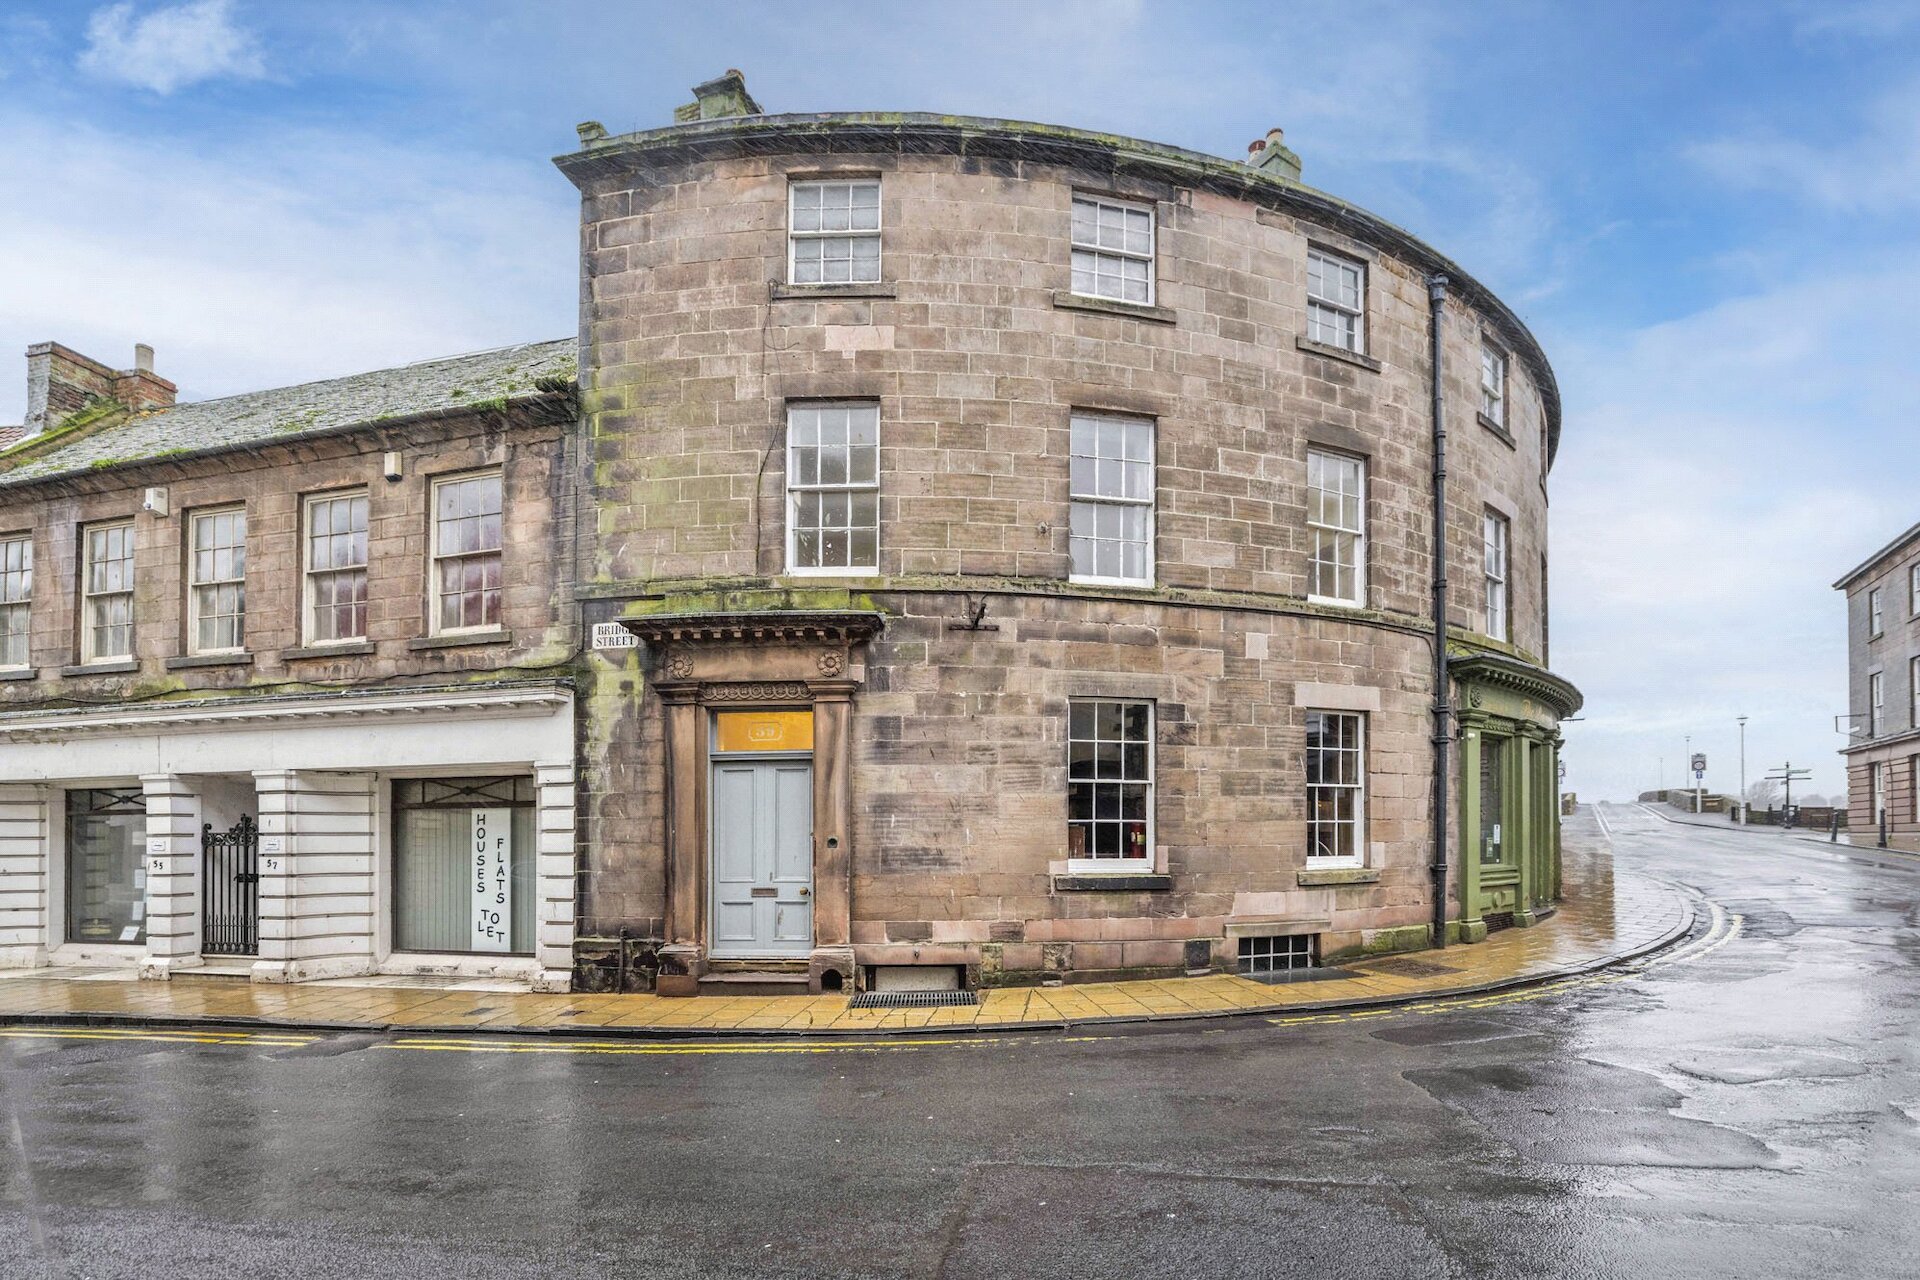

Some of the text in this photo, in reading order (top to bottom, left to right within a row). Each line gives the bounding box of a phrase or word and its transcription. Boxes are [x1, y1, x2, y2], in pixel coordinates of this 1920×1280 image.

[596, 636, 634, 647] STREET
[476, 814, 486, 893] HOUSES
[153, 860, 164, 870] 55
[267, 859, 278, 870] 57
[496, 838, 505, 904] FLATS
[480, 909, 500, 925] TO
[478, 921, 505, 943] LET
